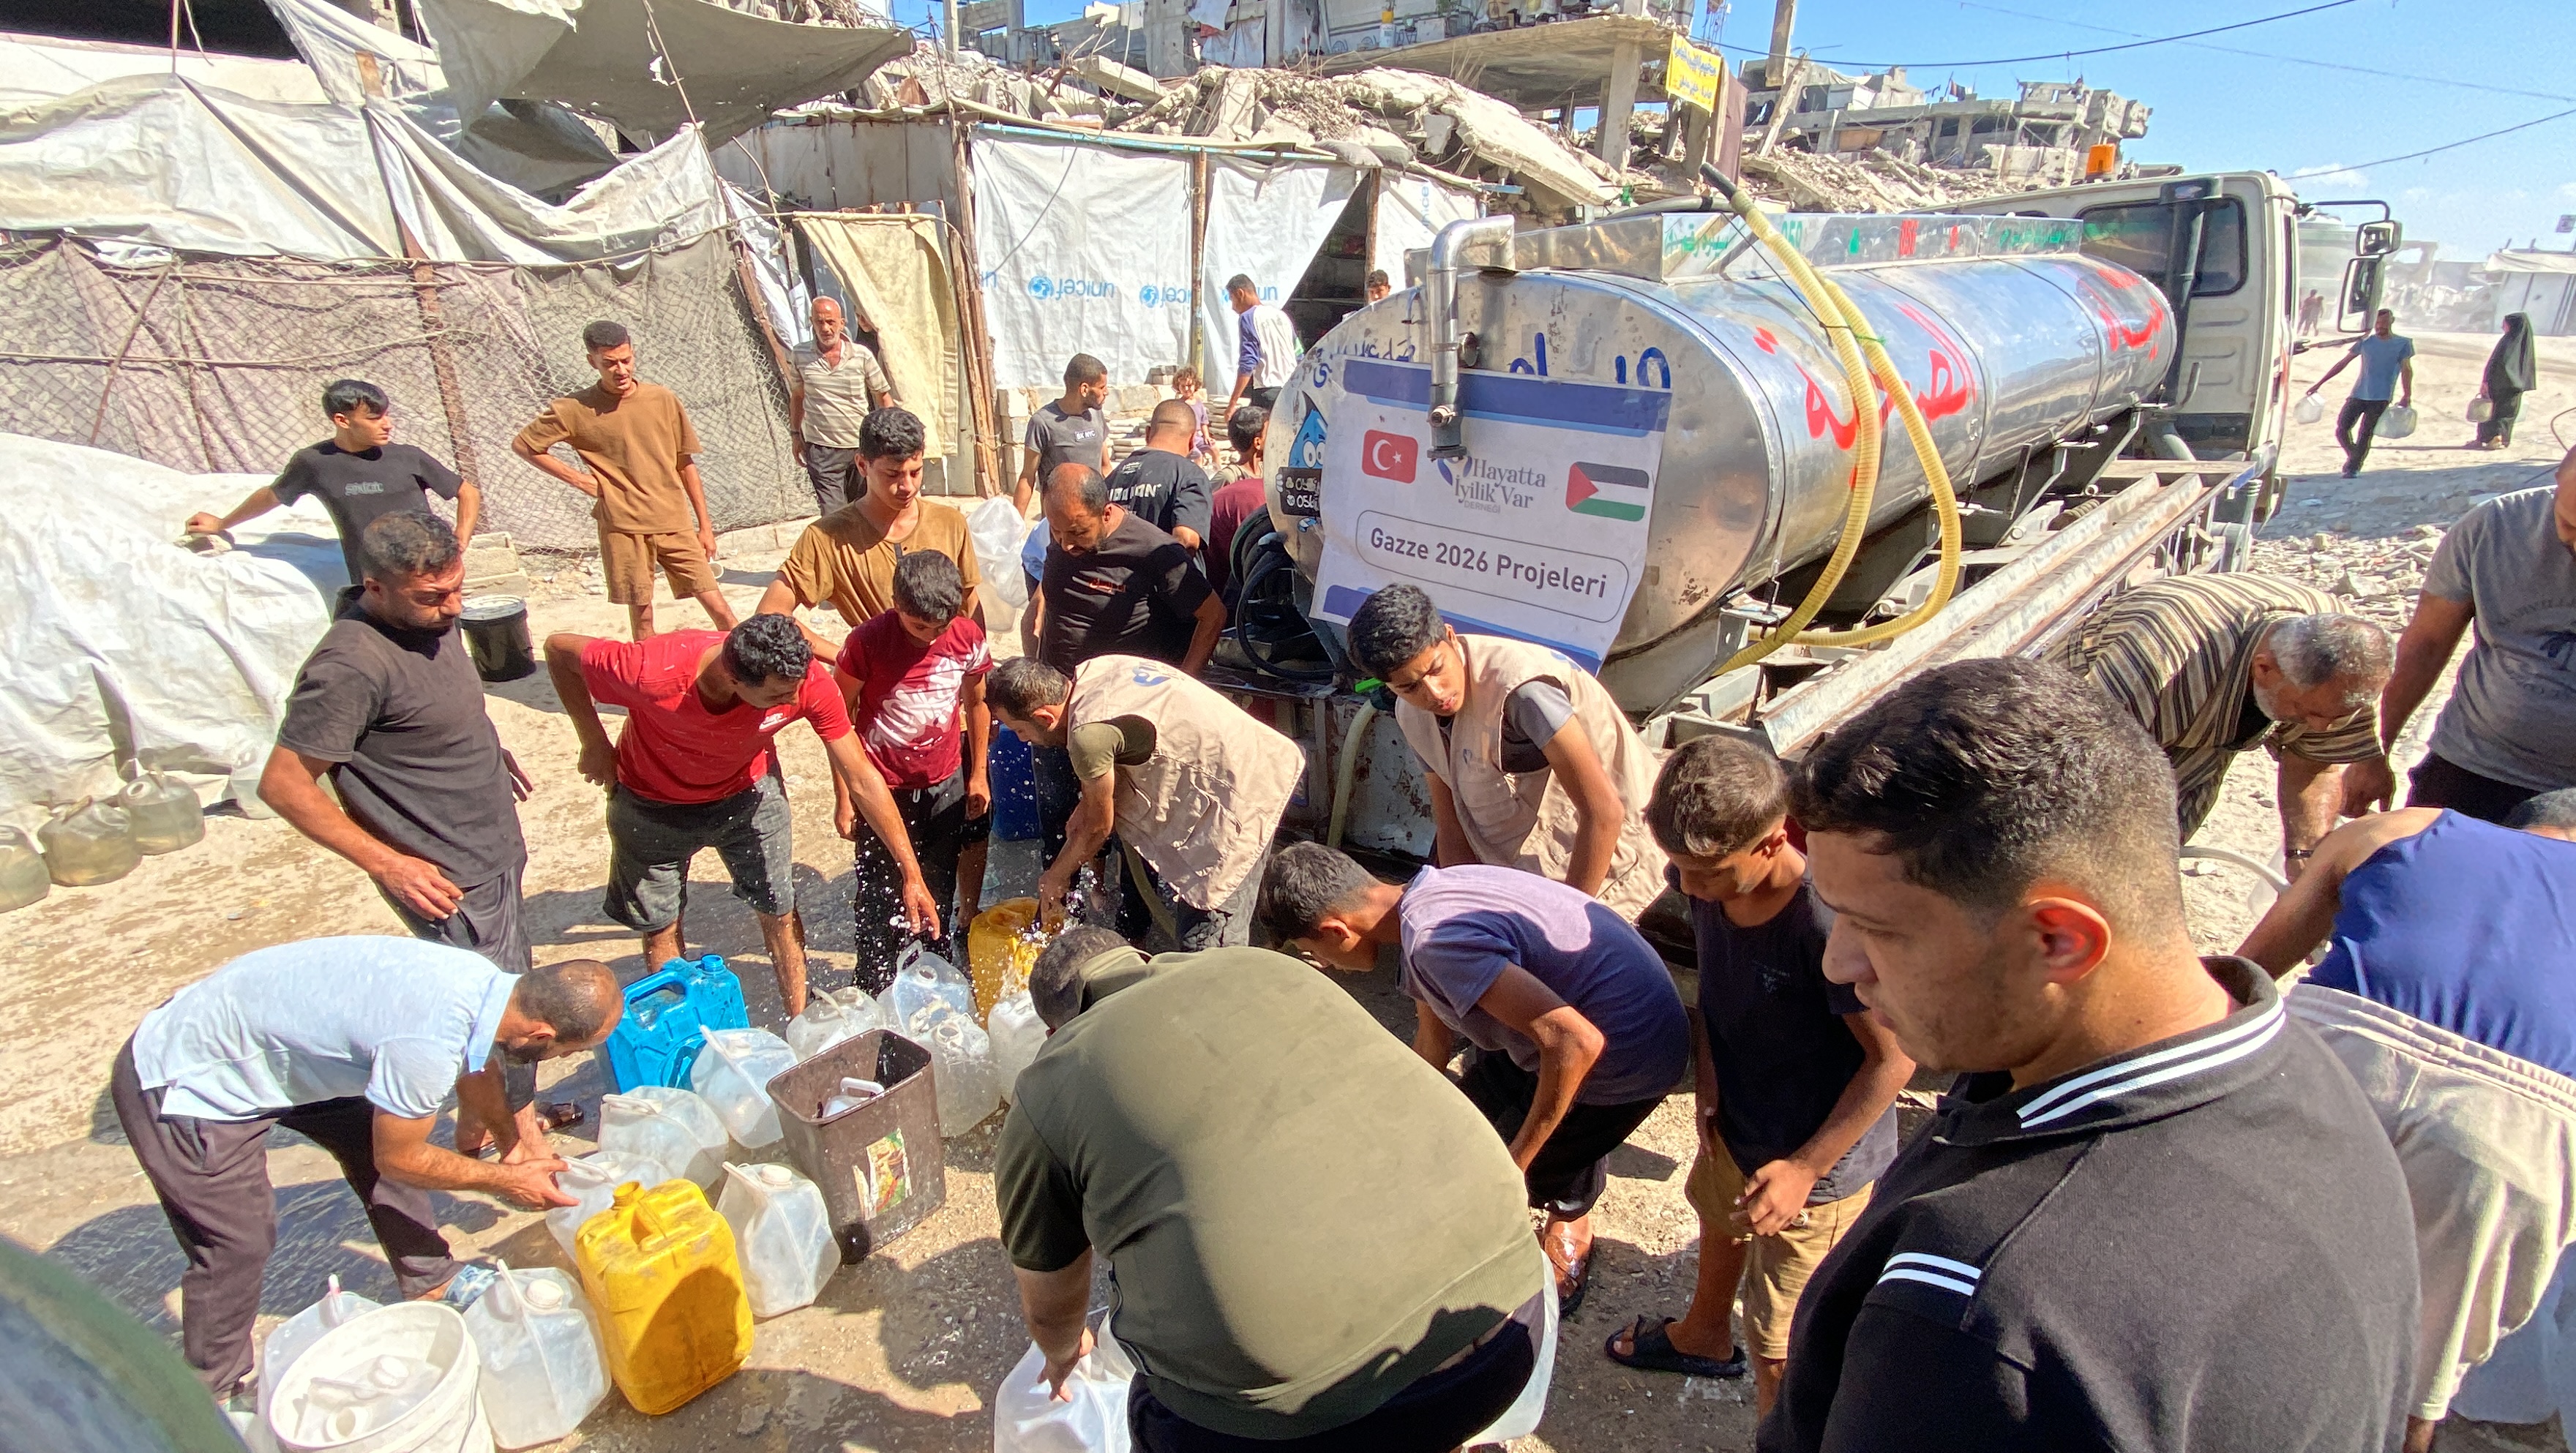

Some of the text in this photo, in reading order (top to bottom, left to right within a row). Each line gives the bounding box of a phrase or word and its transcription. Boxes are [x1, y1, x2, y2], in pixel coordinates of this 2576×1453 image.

[1055, 278, 1115, 301] unicef
[1161, 285, 1191, 309] icef
[1472, 458, 1546, 487] Hayatta
[1454, 475, 1533, 508] İyilik Var
[1370, 527, 1606, 598] Gazze 2026 Projeleri
